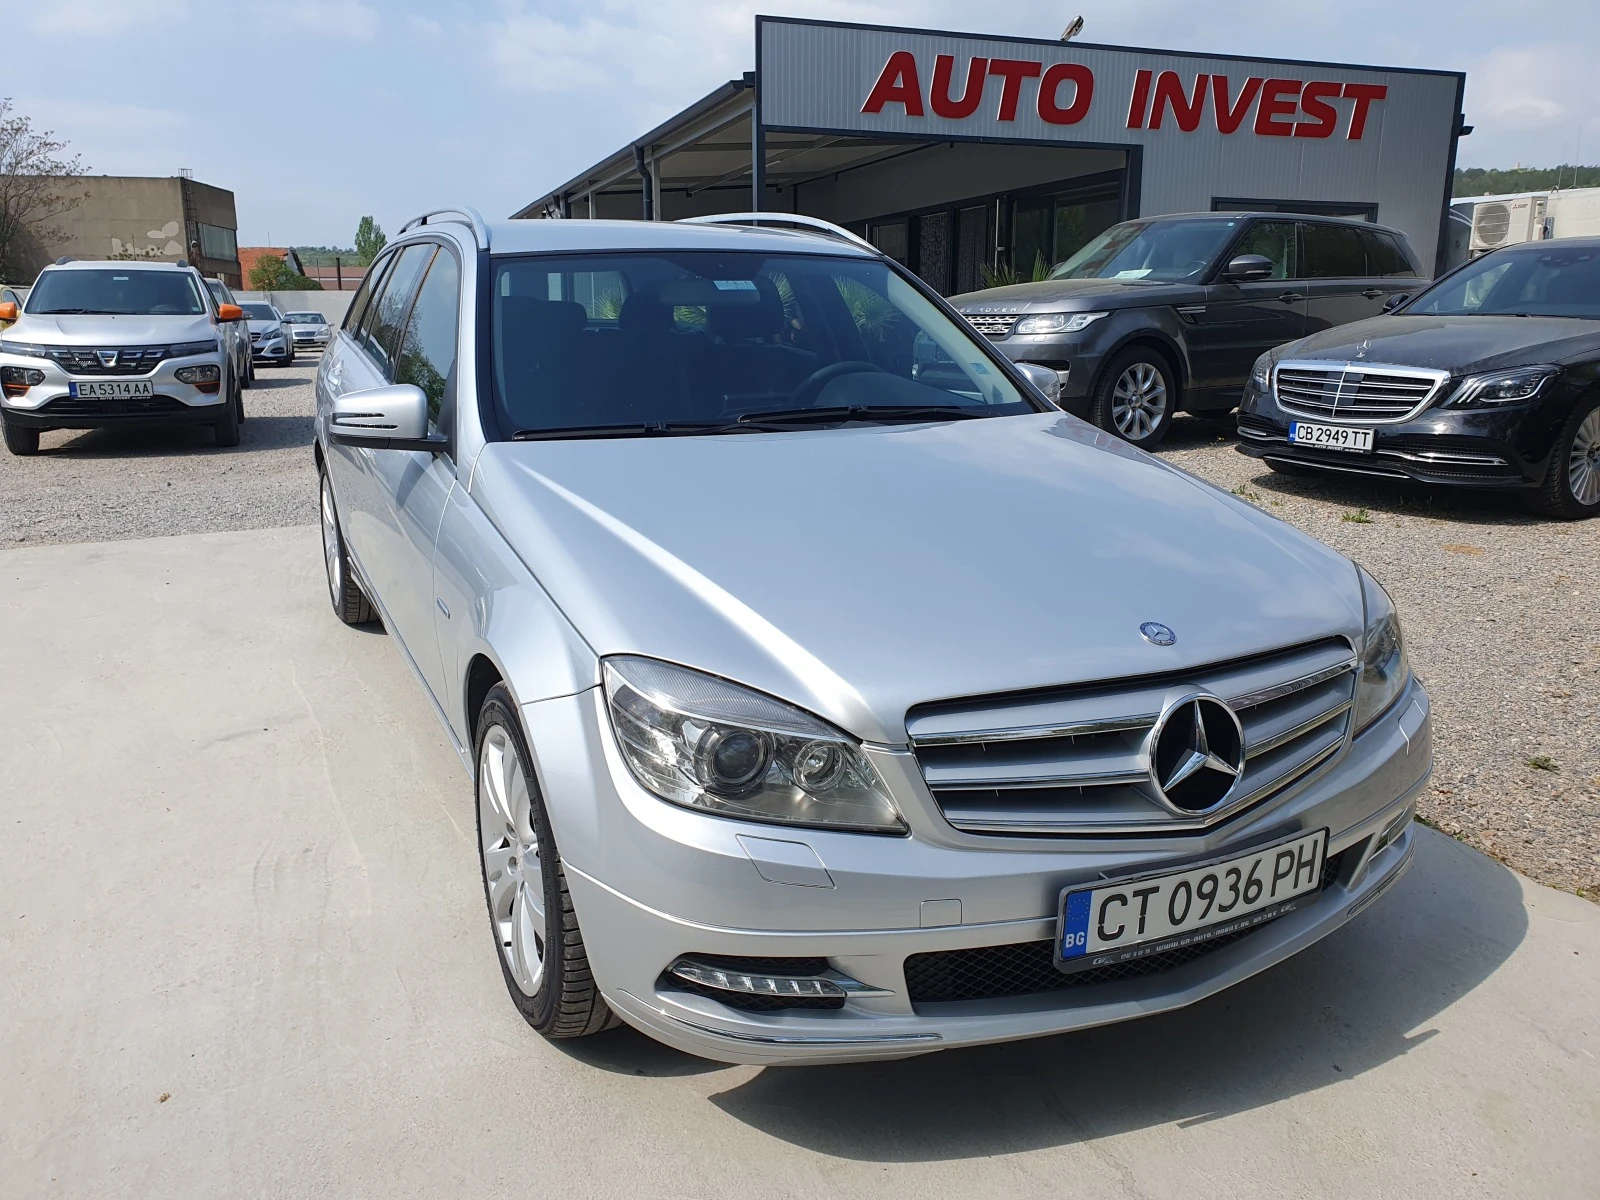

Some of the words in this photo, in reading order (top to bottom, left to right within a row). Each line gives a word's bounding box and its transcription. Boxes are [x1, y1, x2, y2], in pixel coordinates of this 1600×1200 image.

[861, 50, 1095, 125] AUTO
[1126, 69, 1389, 141] INVEST
[78, 384, 97, 396] EA
[98, 383, 131, 395] 5314
[134, 383, 150, 395] AA
[1297, 425, 1314, 441] CB
[1315, 427, 1349, 445] 2949
[1352, 431, 1371, 447] TT
[1097, 886, 1160, 942] CT
[1167, 859, 1263, 927] 0936
[1269, 838, 1319, 897] PH
[1065, 931, 1085, 948] BG
